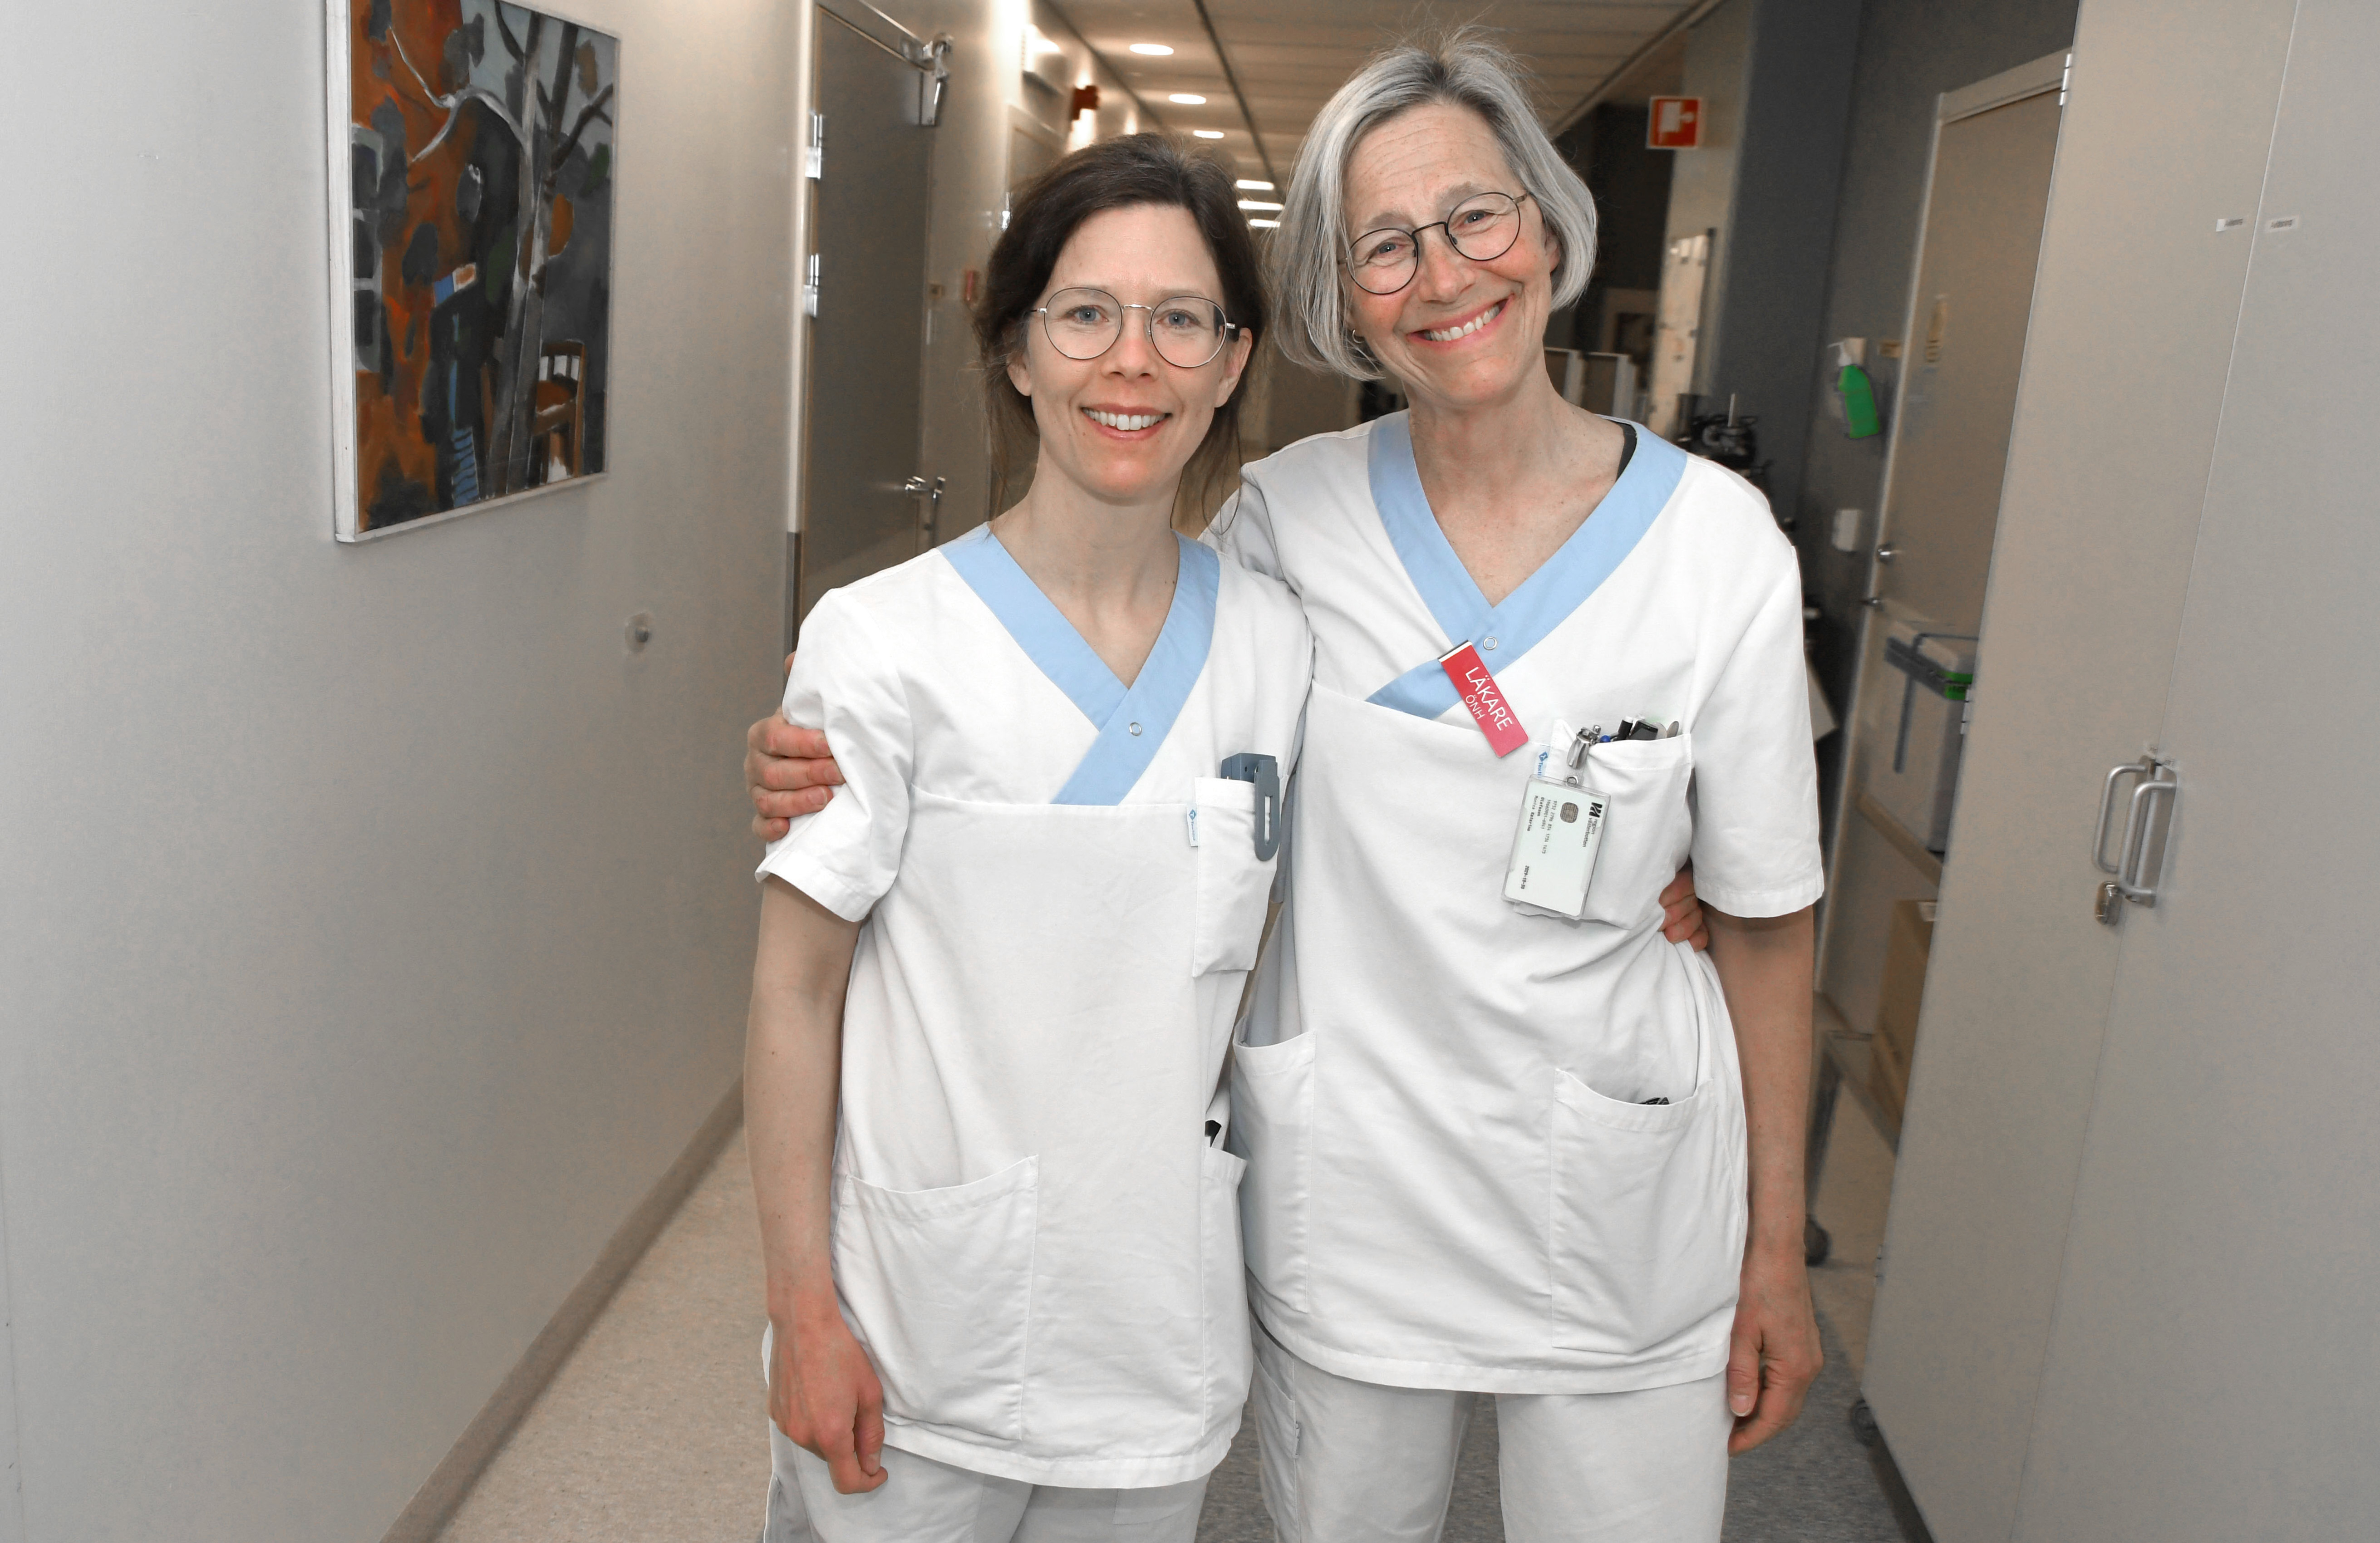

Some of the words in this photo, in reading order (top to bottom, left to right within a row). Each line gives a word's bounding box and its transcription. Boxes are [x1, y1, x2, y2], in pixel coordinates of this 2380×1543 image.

[1465, 666, 1513, 731] LÄKARE
[1465, 694, 1485, 720] ÖNH
[1582, 817, 1593, 847] västerbotten
